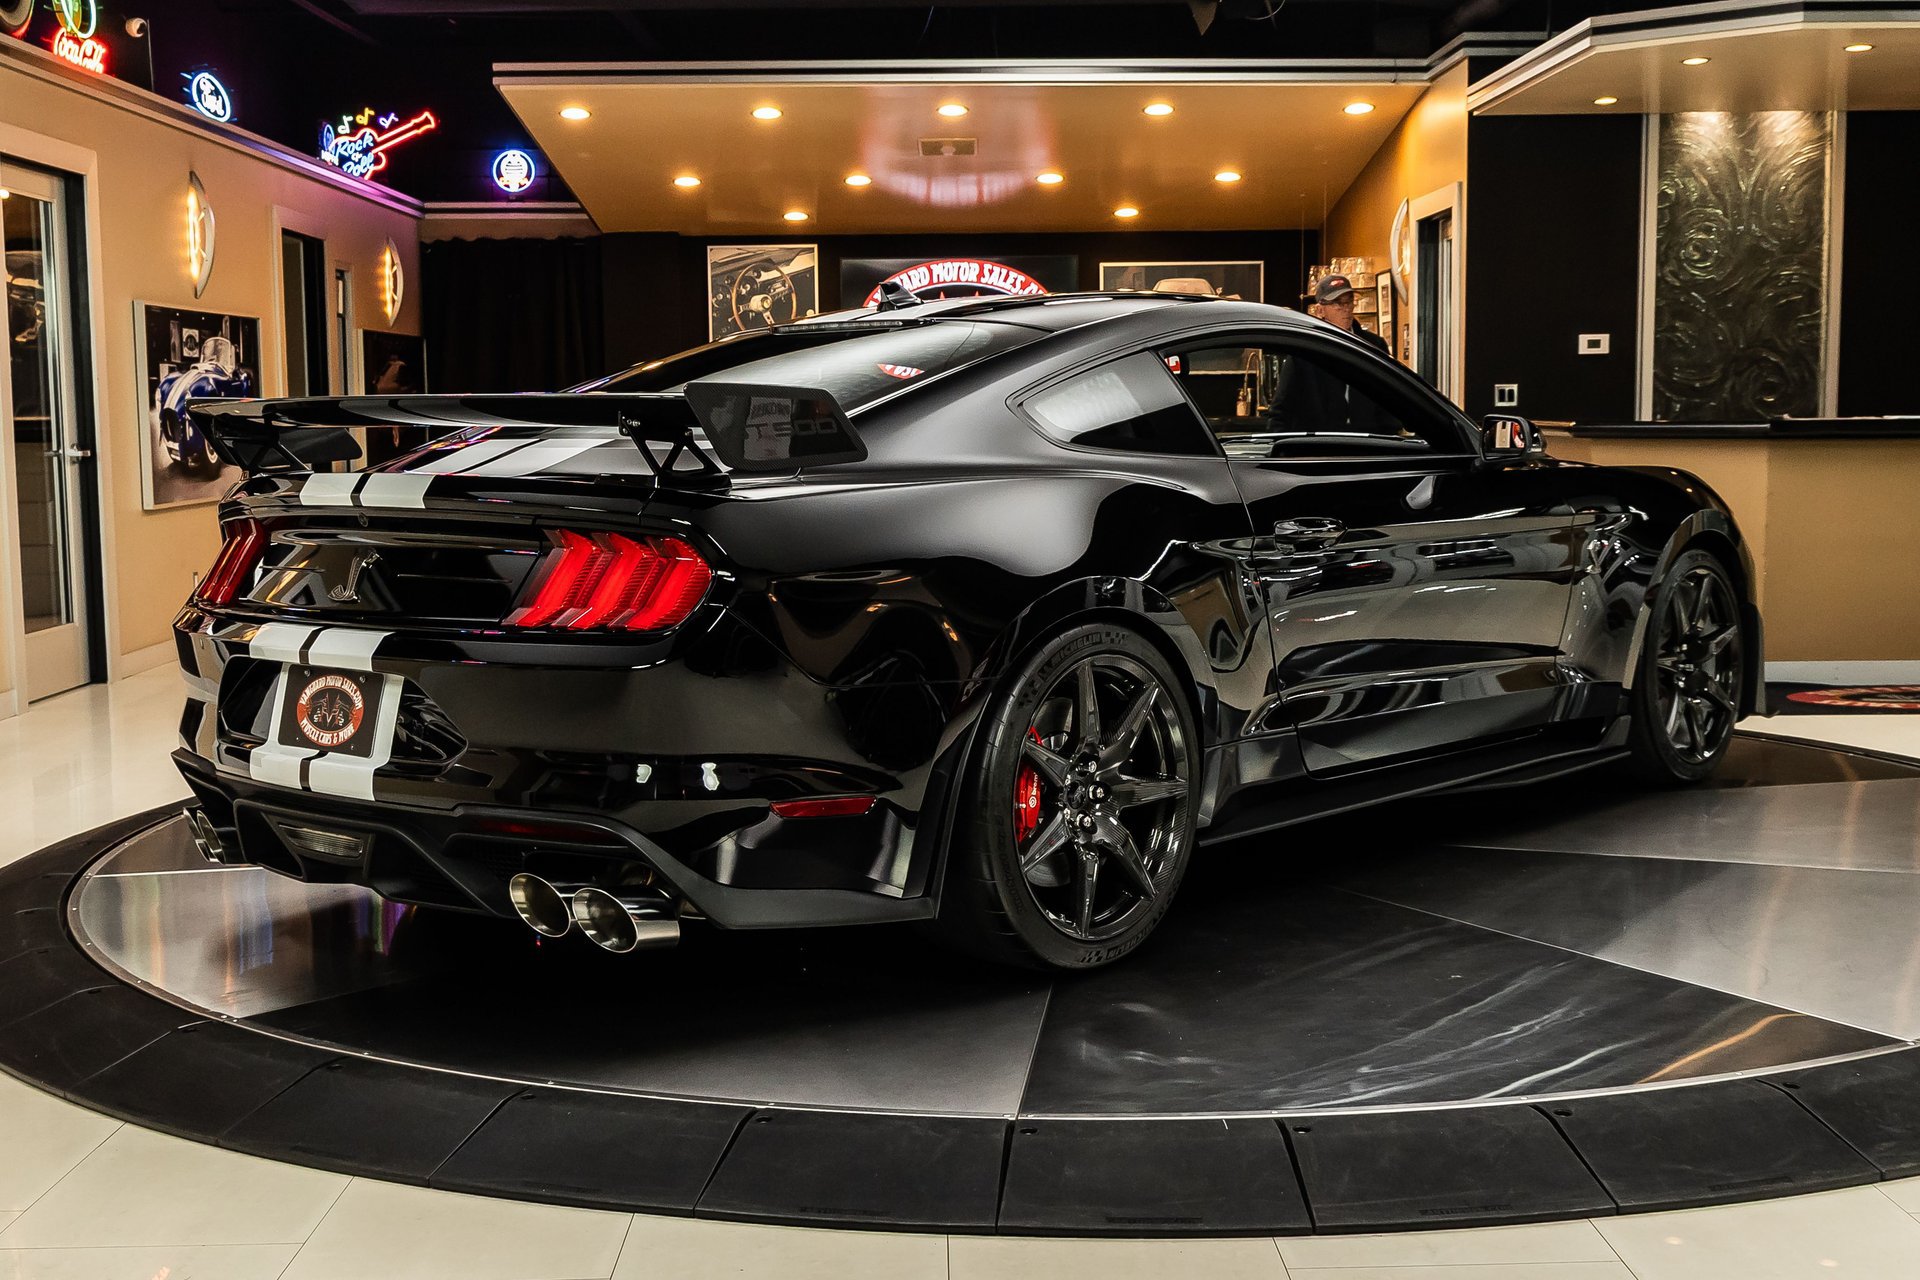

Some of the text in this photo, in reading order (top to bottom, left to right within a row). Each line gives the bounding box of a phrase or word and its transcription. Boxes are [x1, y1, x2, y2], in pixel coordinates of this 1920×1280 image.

[336, 131, 374, 159] Rock
[930, 261, 980, 284] MOTOR
[319, 733, 332, 745] CARS
